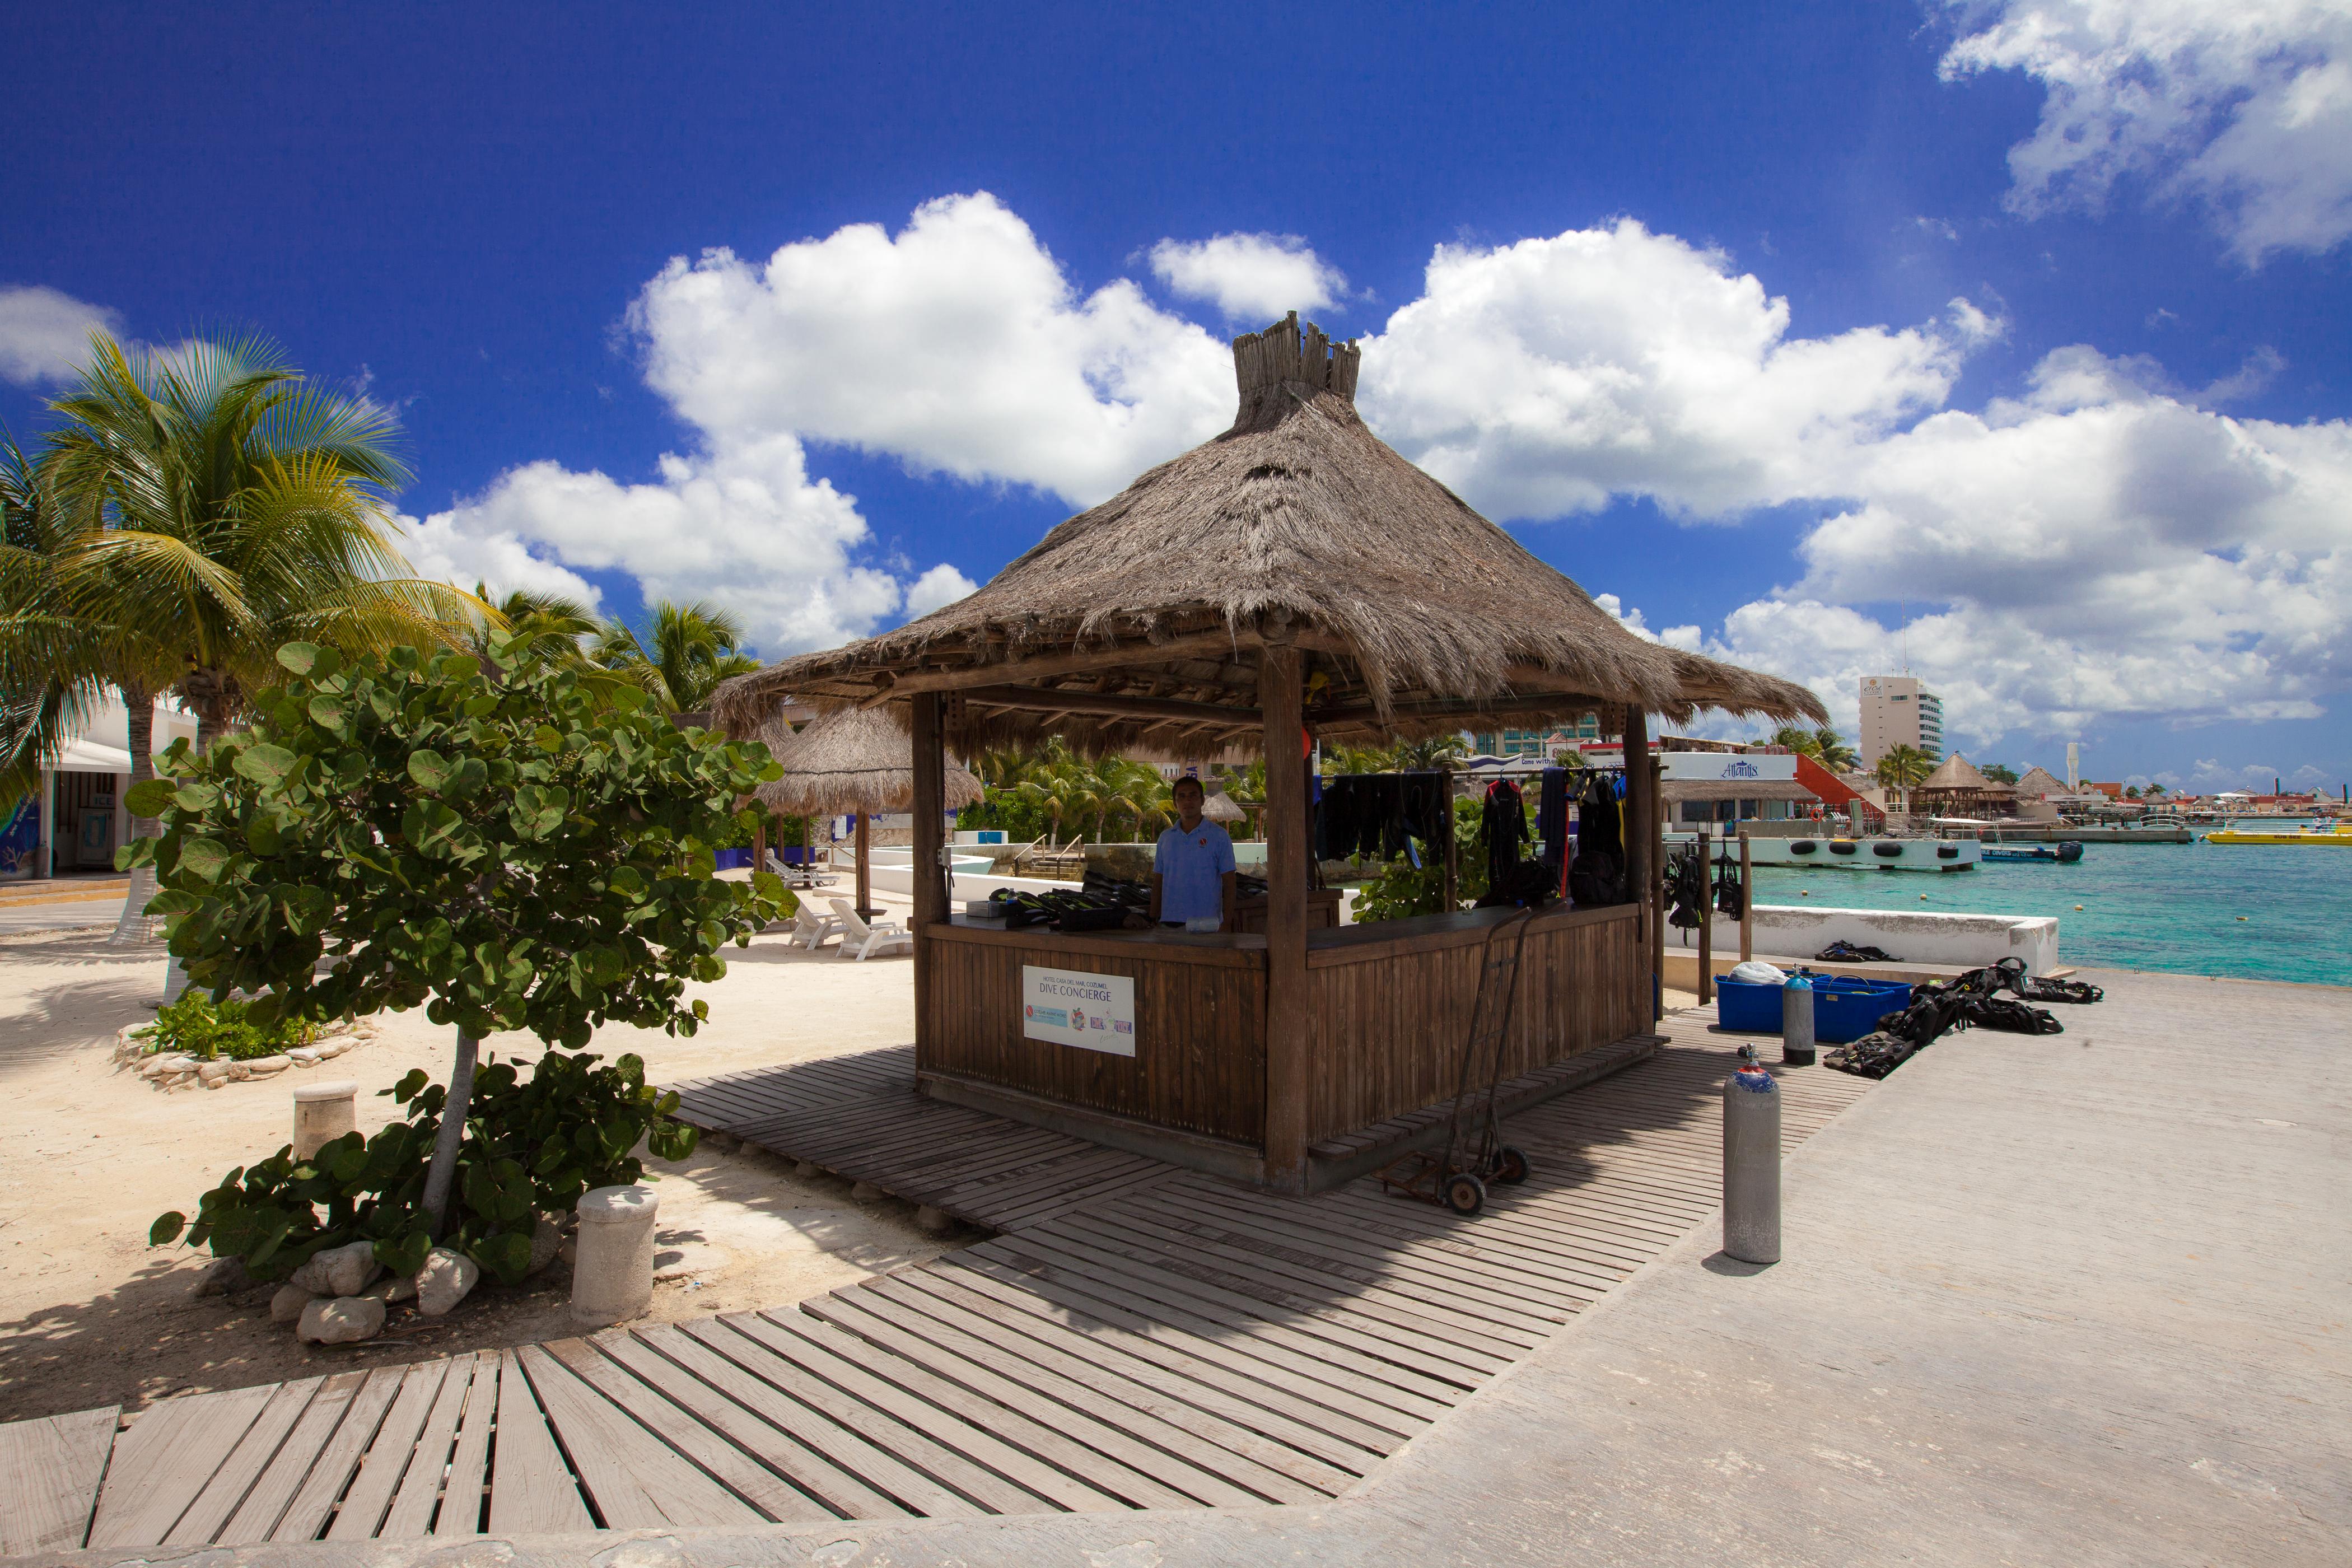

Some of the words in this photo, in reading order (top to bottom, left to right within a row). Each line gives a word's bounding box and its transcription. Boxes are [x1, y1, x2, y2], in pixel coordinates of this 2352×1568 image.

[1721, 763, 1758, 778] Atlantis
[95, 797, 113, 806] ICE
[1040, 983, 1057, 995] DIVE
[1060, 986, 1112, 1002] CONCIERGE
